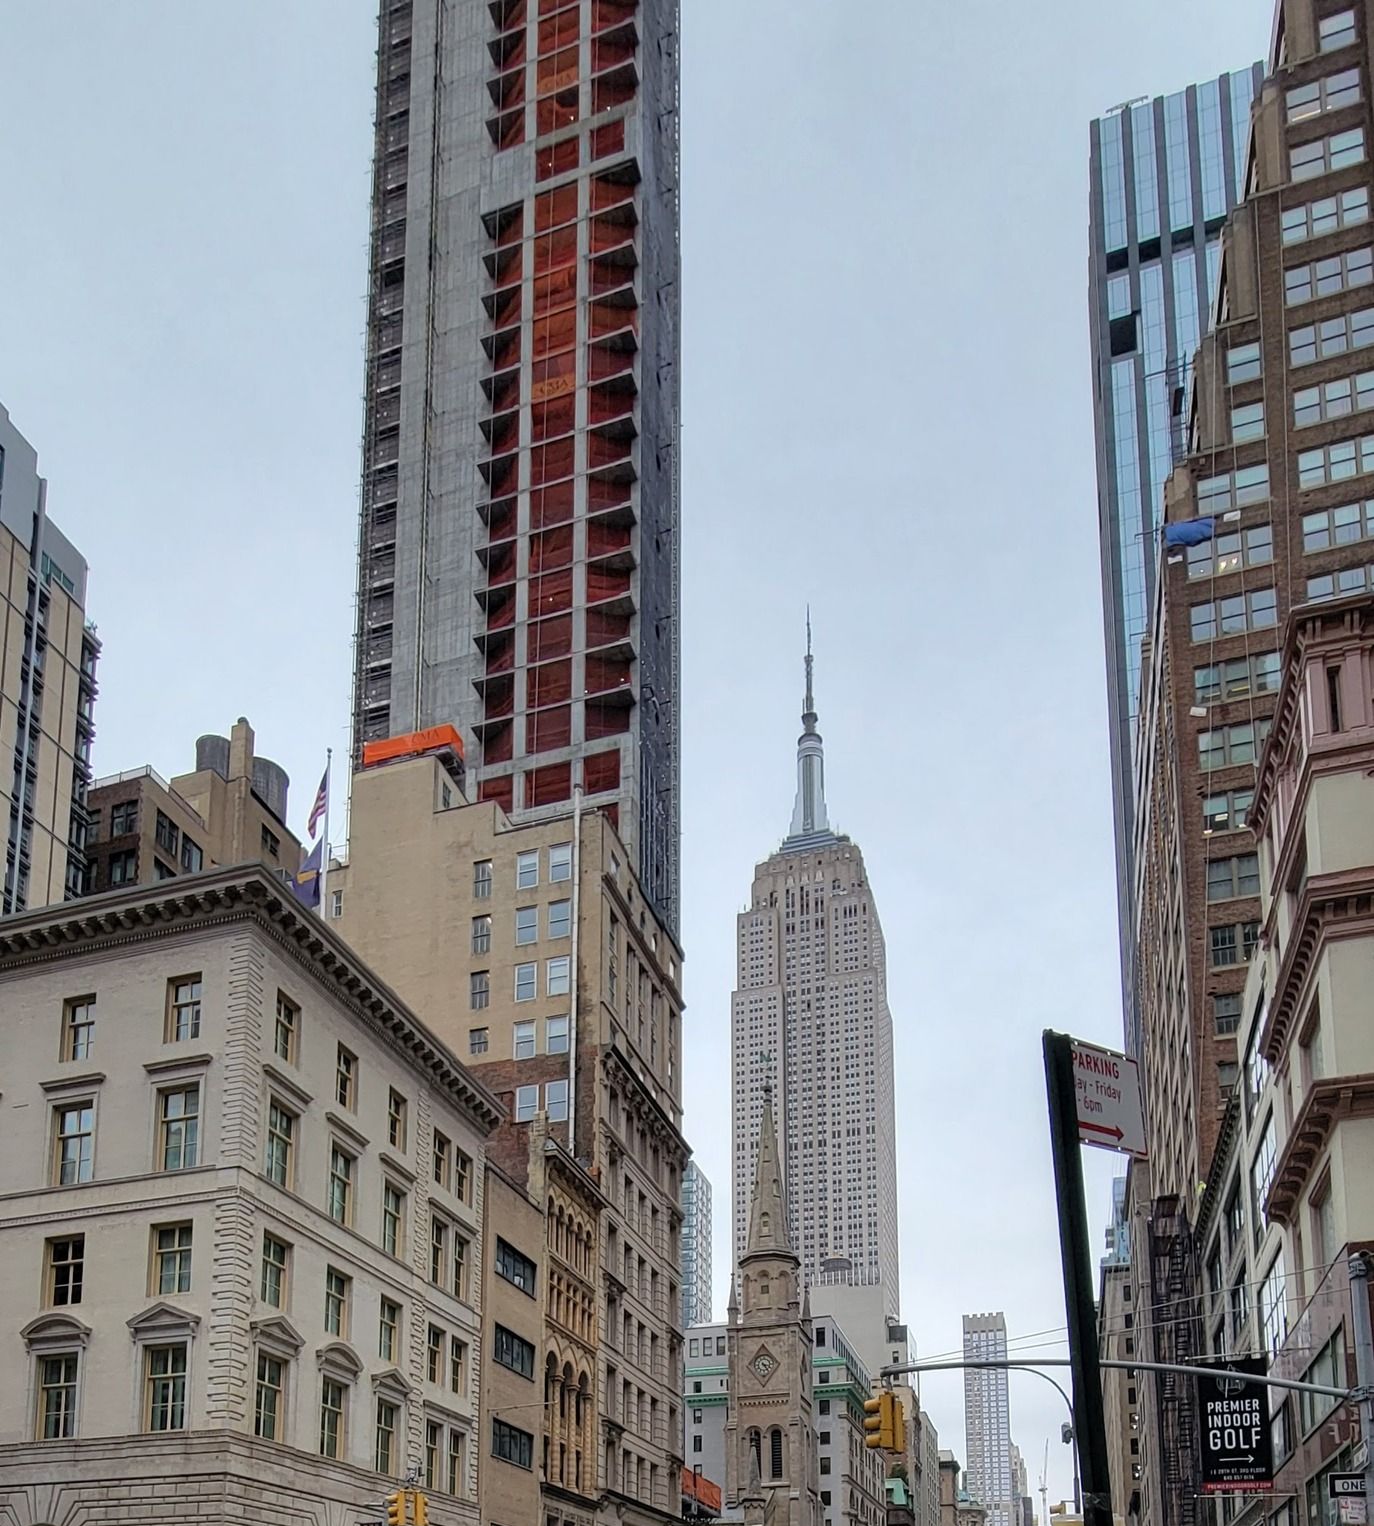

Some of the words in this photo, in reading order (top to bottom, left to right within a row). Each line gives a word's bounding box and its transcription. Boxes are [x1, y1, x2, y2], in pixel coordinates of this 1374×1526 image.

[1072, 1050, 1119, 1079] PARKING
[1095, 1080, 1121, 1104] Friday
[1083, 1096, 1103, 1113] 6pm
[1207, 1399, 1260, 1414] PREMIER
[1208, 1412, 1261, 1428] INDOOR
[1209, 1427, 1261, 1451] GOLF
[1342, 1480, 1366, 1491] ONE
